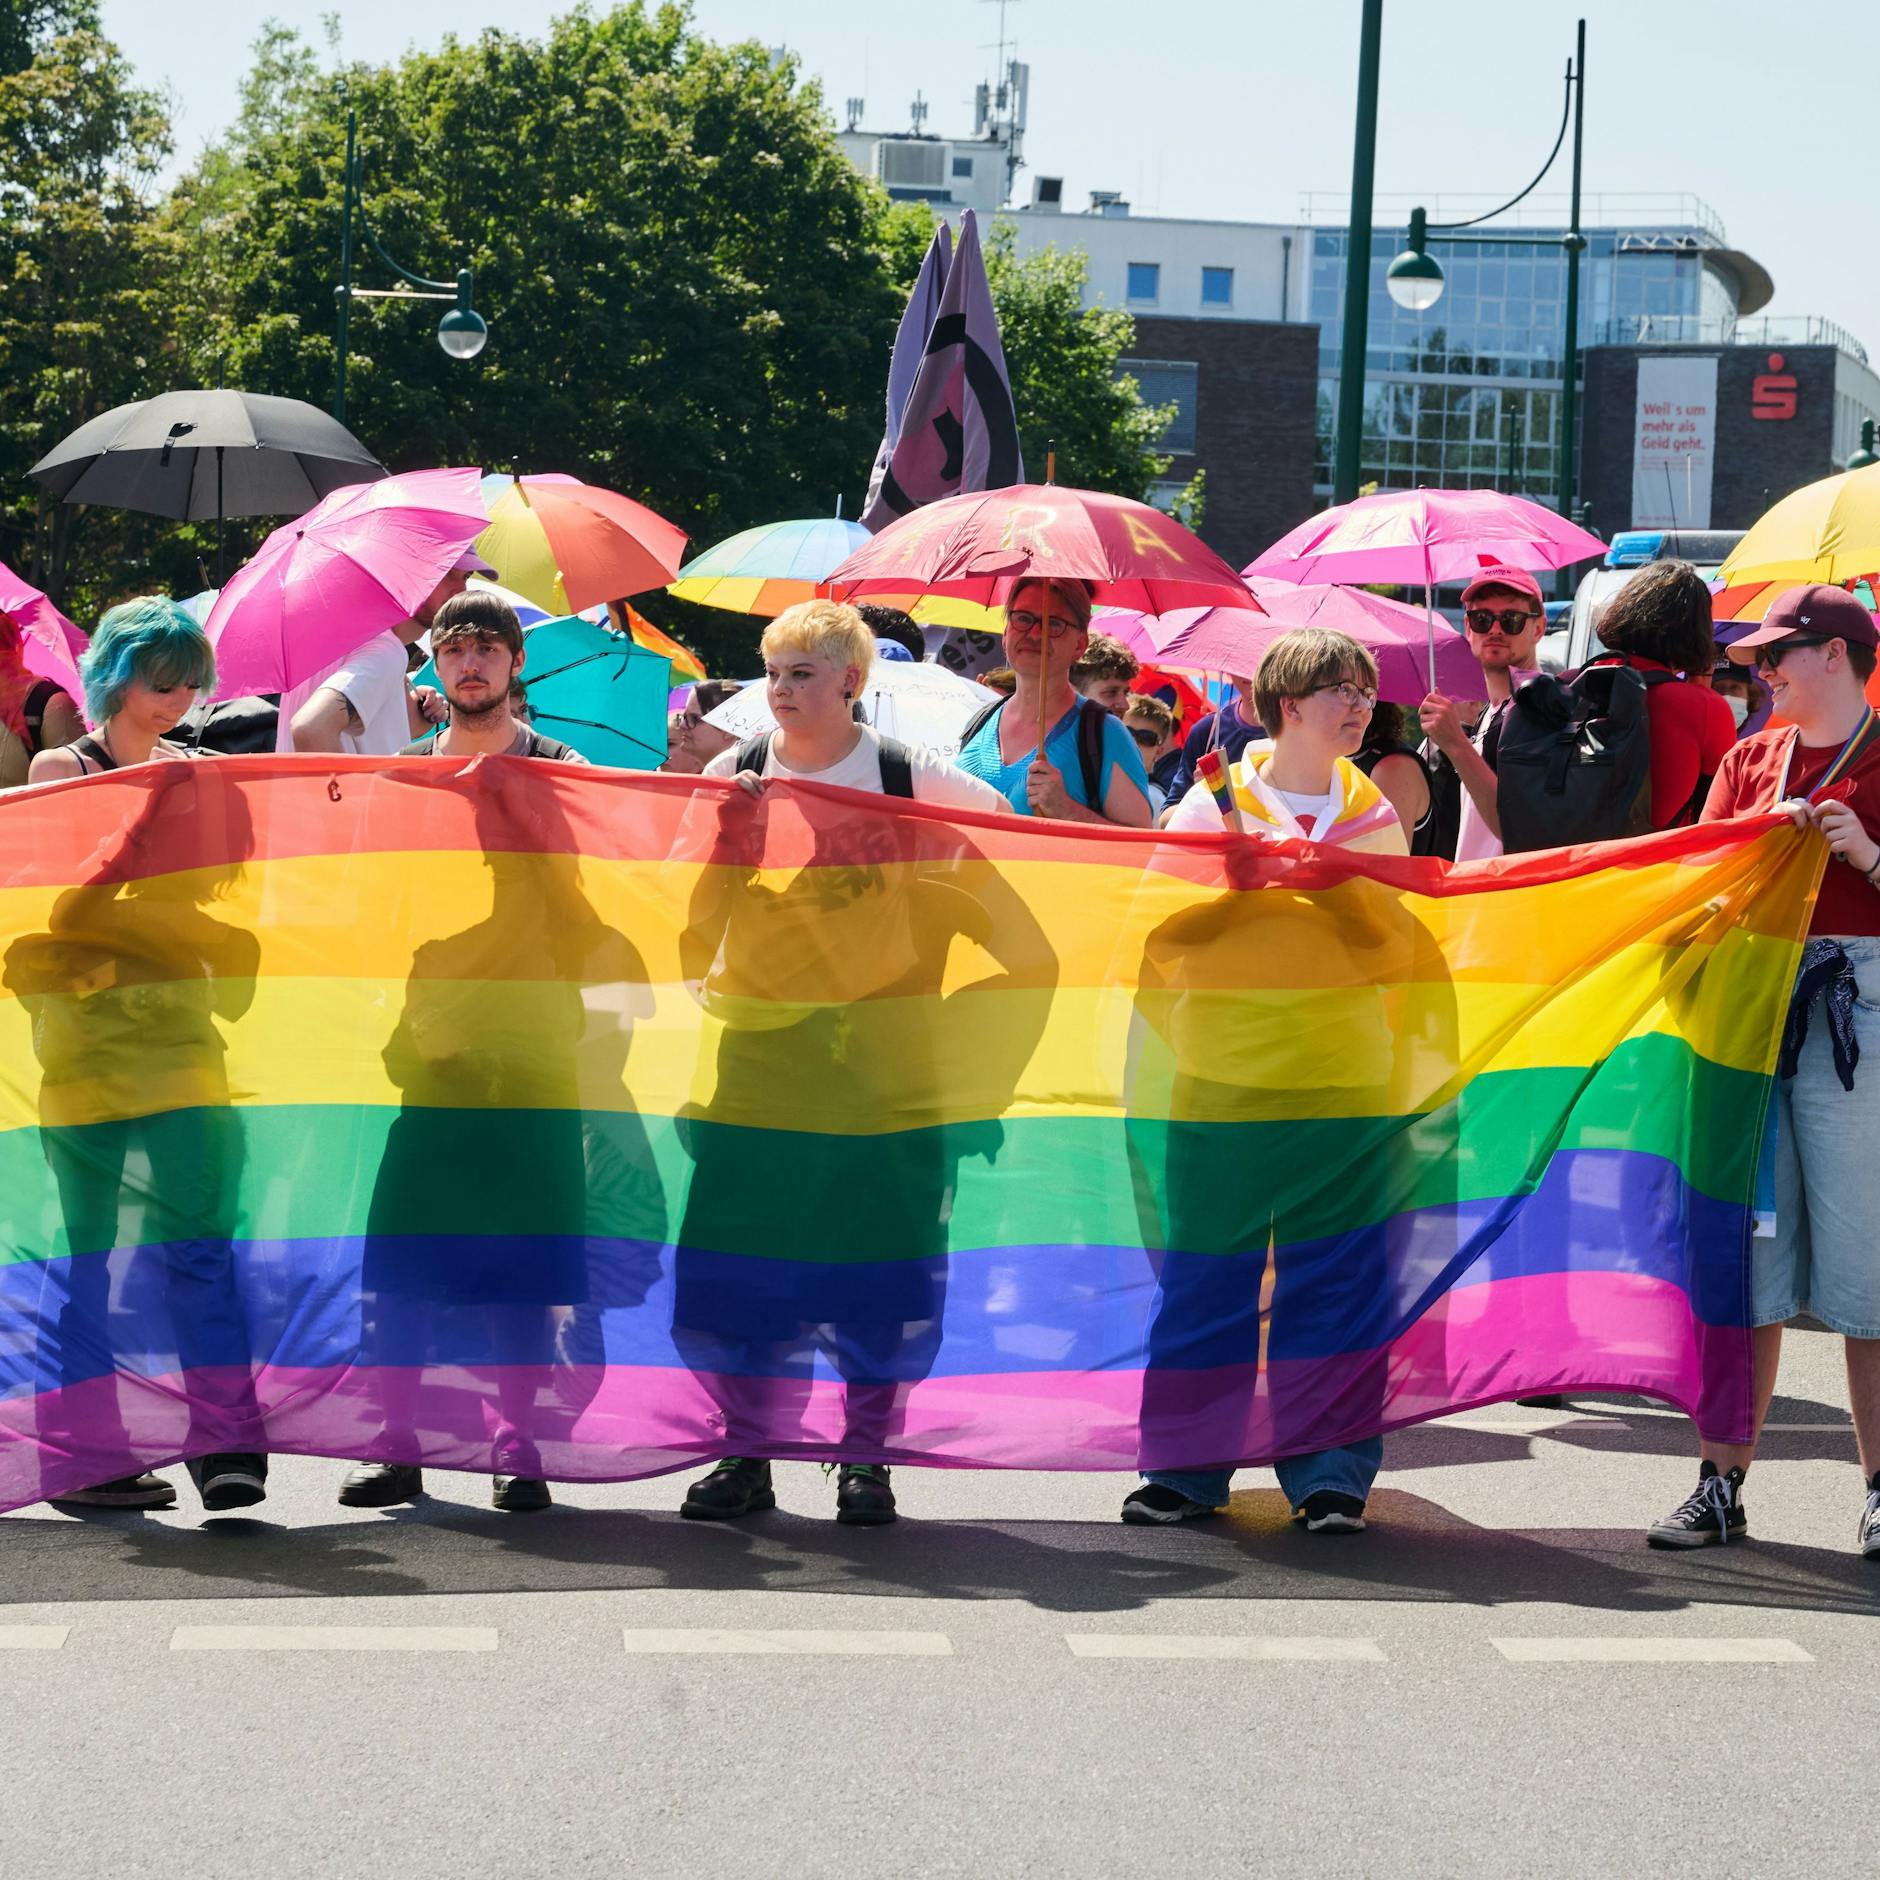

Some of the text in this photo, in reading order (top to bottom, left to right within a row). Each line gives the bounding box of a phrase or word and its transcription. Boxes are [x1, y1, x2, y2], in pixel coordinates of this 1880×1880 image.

[1685, 405, 1707, 416] um
[1642, 419, 1697, 433] mehr als
[1641, 435, 1706, 453] Geld geht.
